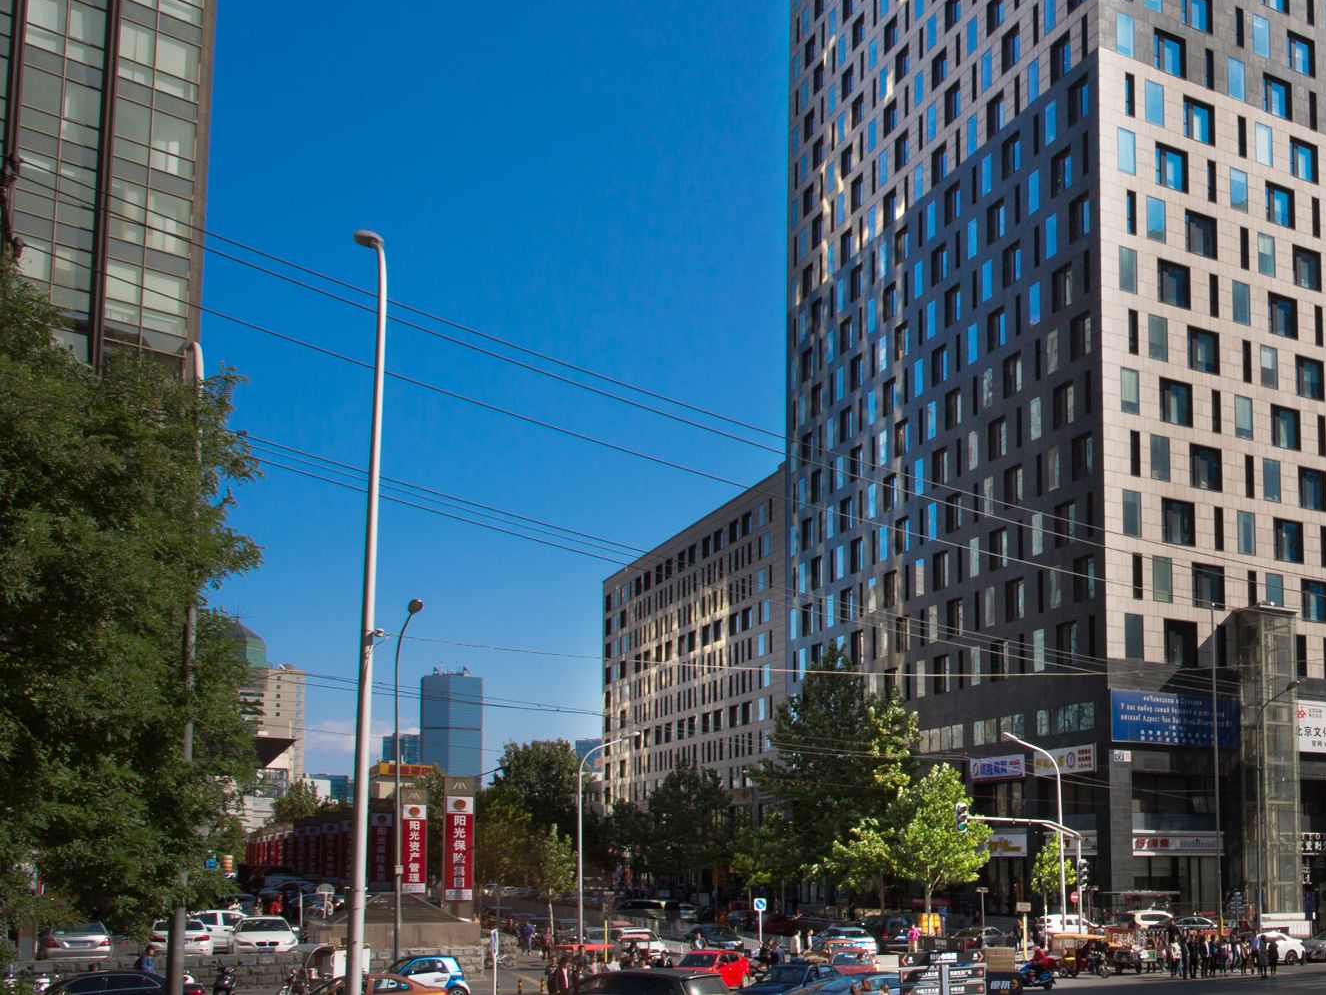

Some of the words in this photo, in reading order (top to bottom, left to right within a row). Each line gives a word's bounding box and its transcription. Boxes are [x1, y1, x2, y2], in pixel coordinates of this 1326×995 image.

[408, 820, 421, 883] 阳光资产管理
[453, 815, 466, 888] 阳光保险集团
